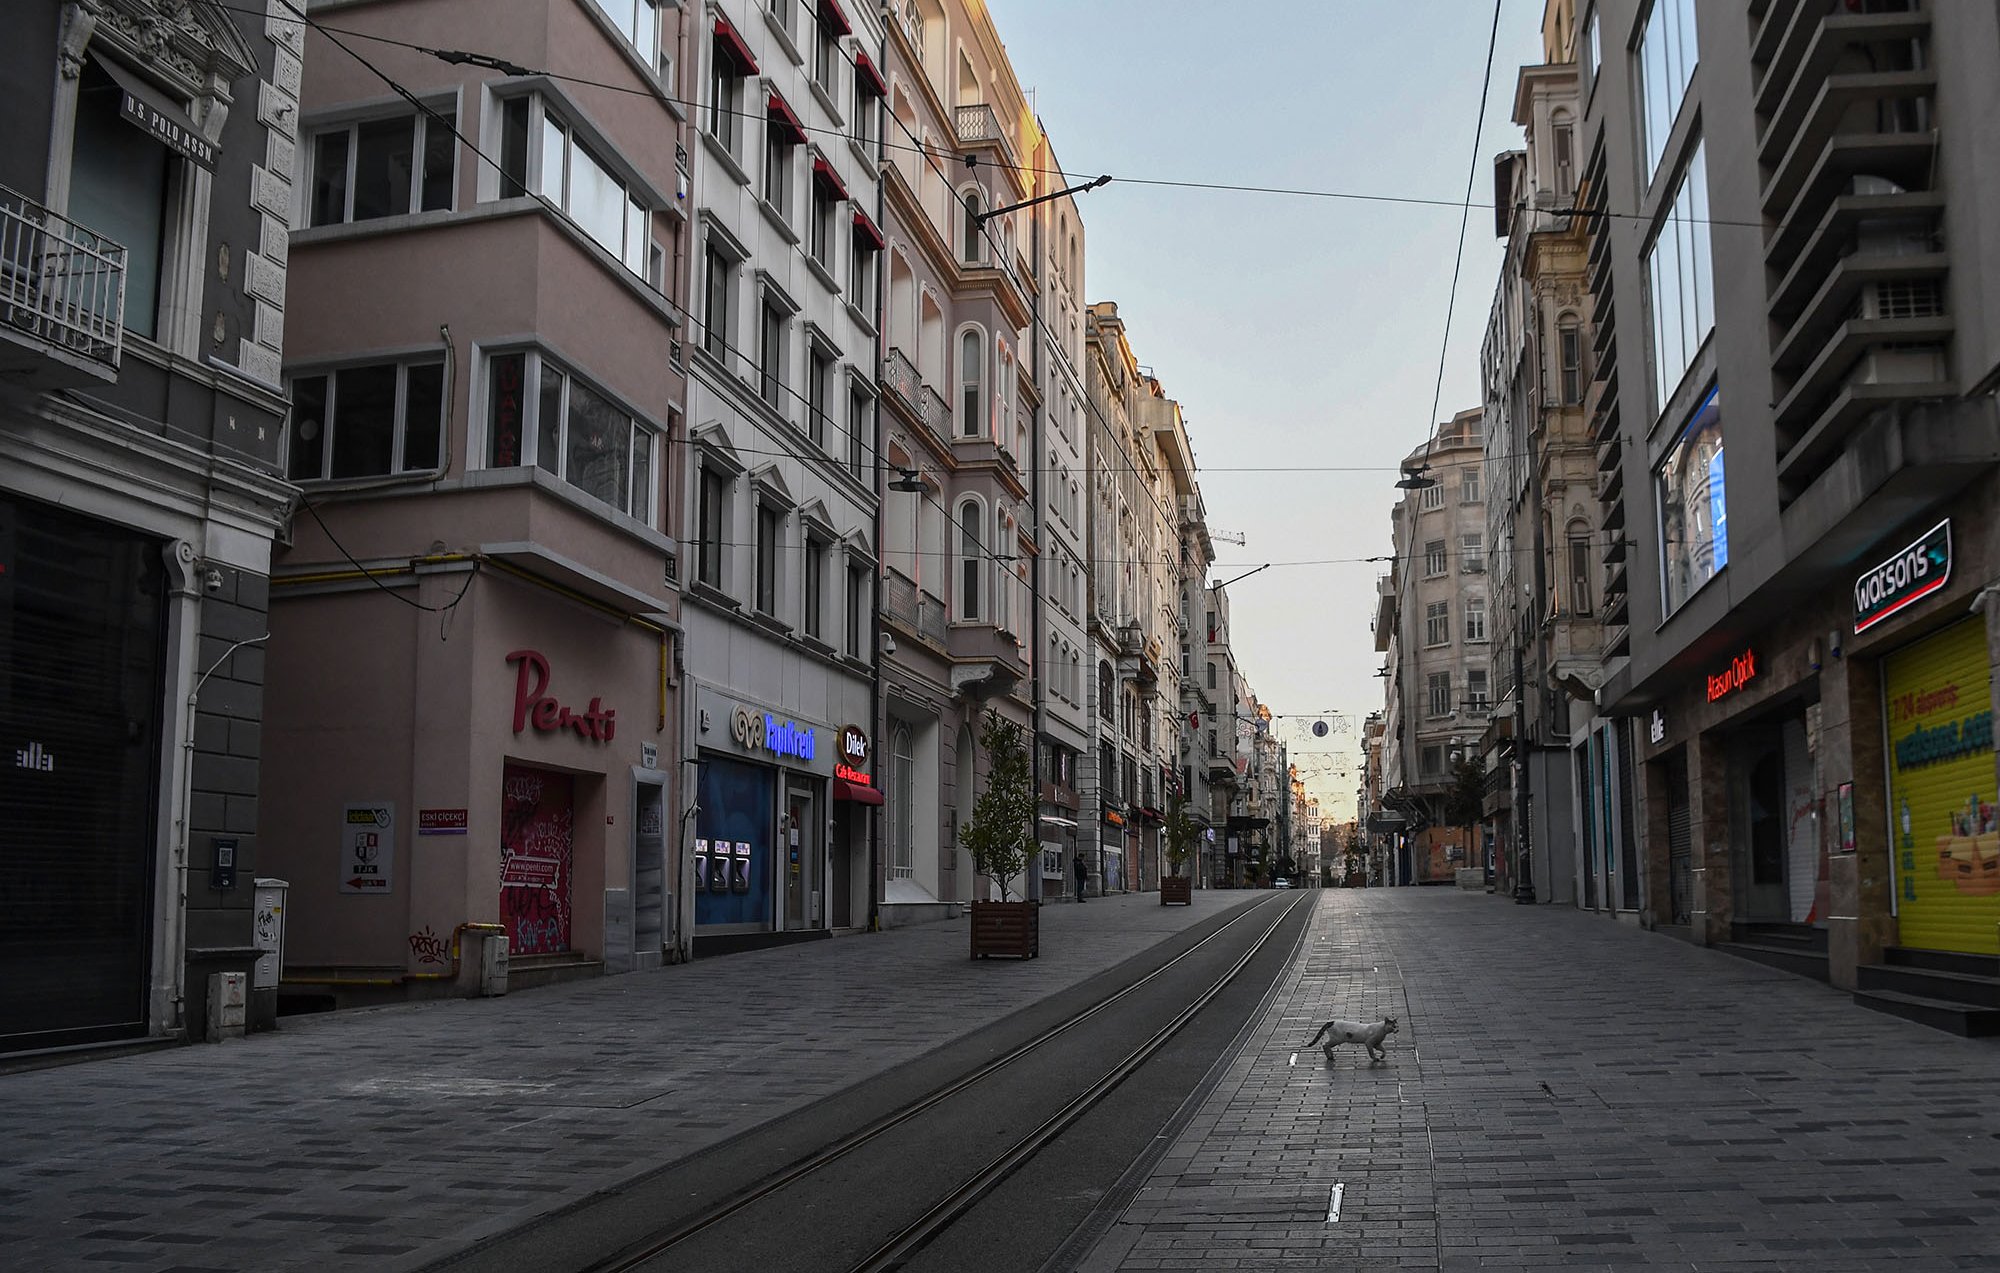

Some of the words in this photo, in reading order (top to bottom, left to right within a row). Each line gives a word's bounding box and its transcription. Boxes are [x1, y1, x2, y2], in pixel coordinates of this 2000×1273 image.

[127, 96, 147, 122] U.S.
[151, 112, 179, 142] POLO
[183, 133, 214, 164] ASSN.
[1855, 544, 1928, 612] watsons
[505, 649, 616, 742] Penti
[1707, 670, 1732, 704] Atasun
[1732, 648, 1755, 692] Optik
[846, 731, 866, 758] Dilek
[510, 861, 554, 874] www.penti.com
